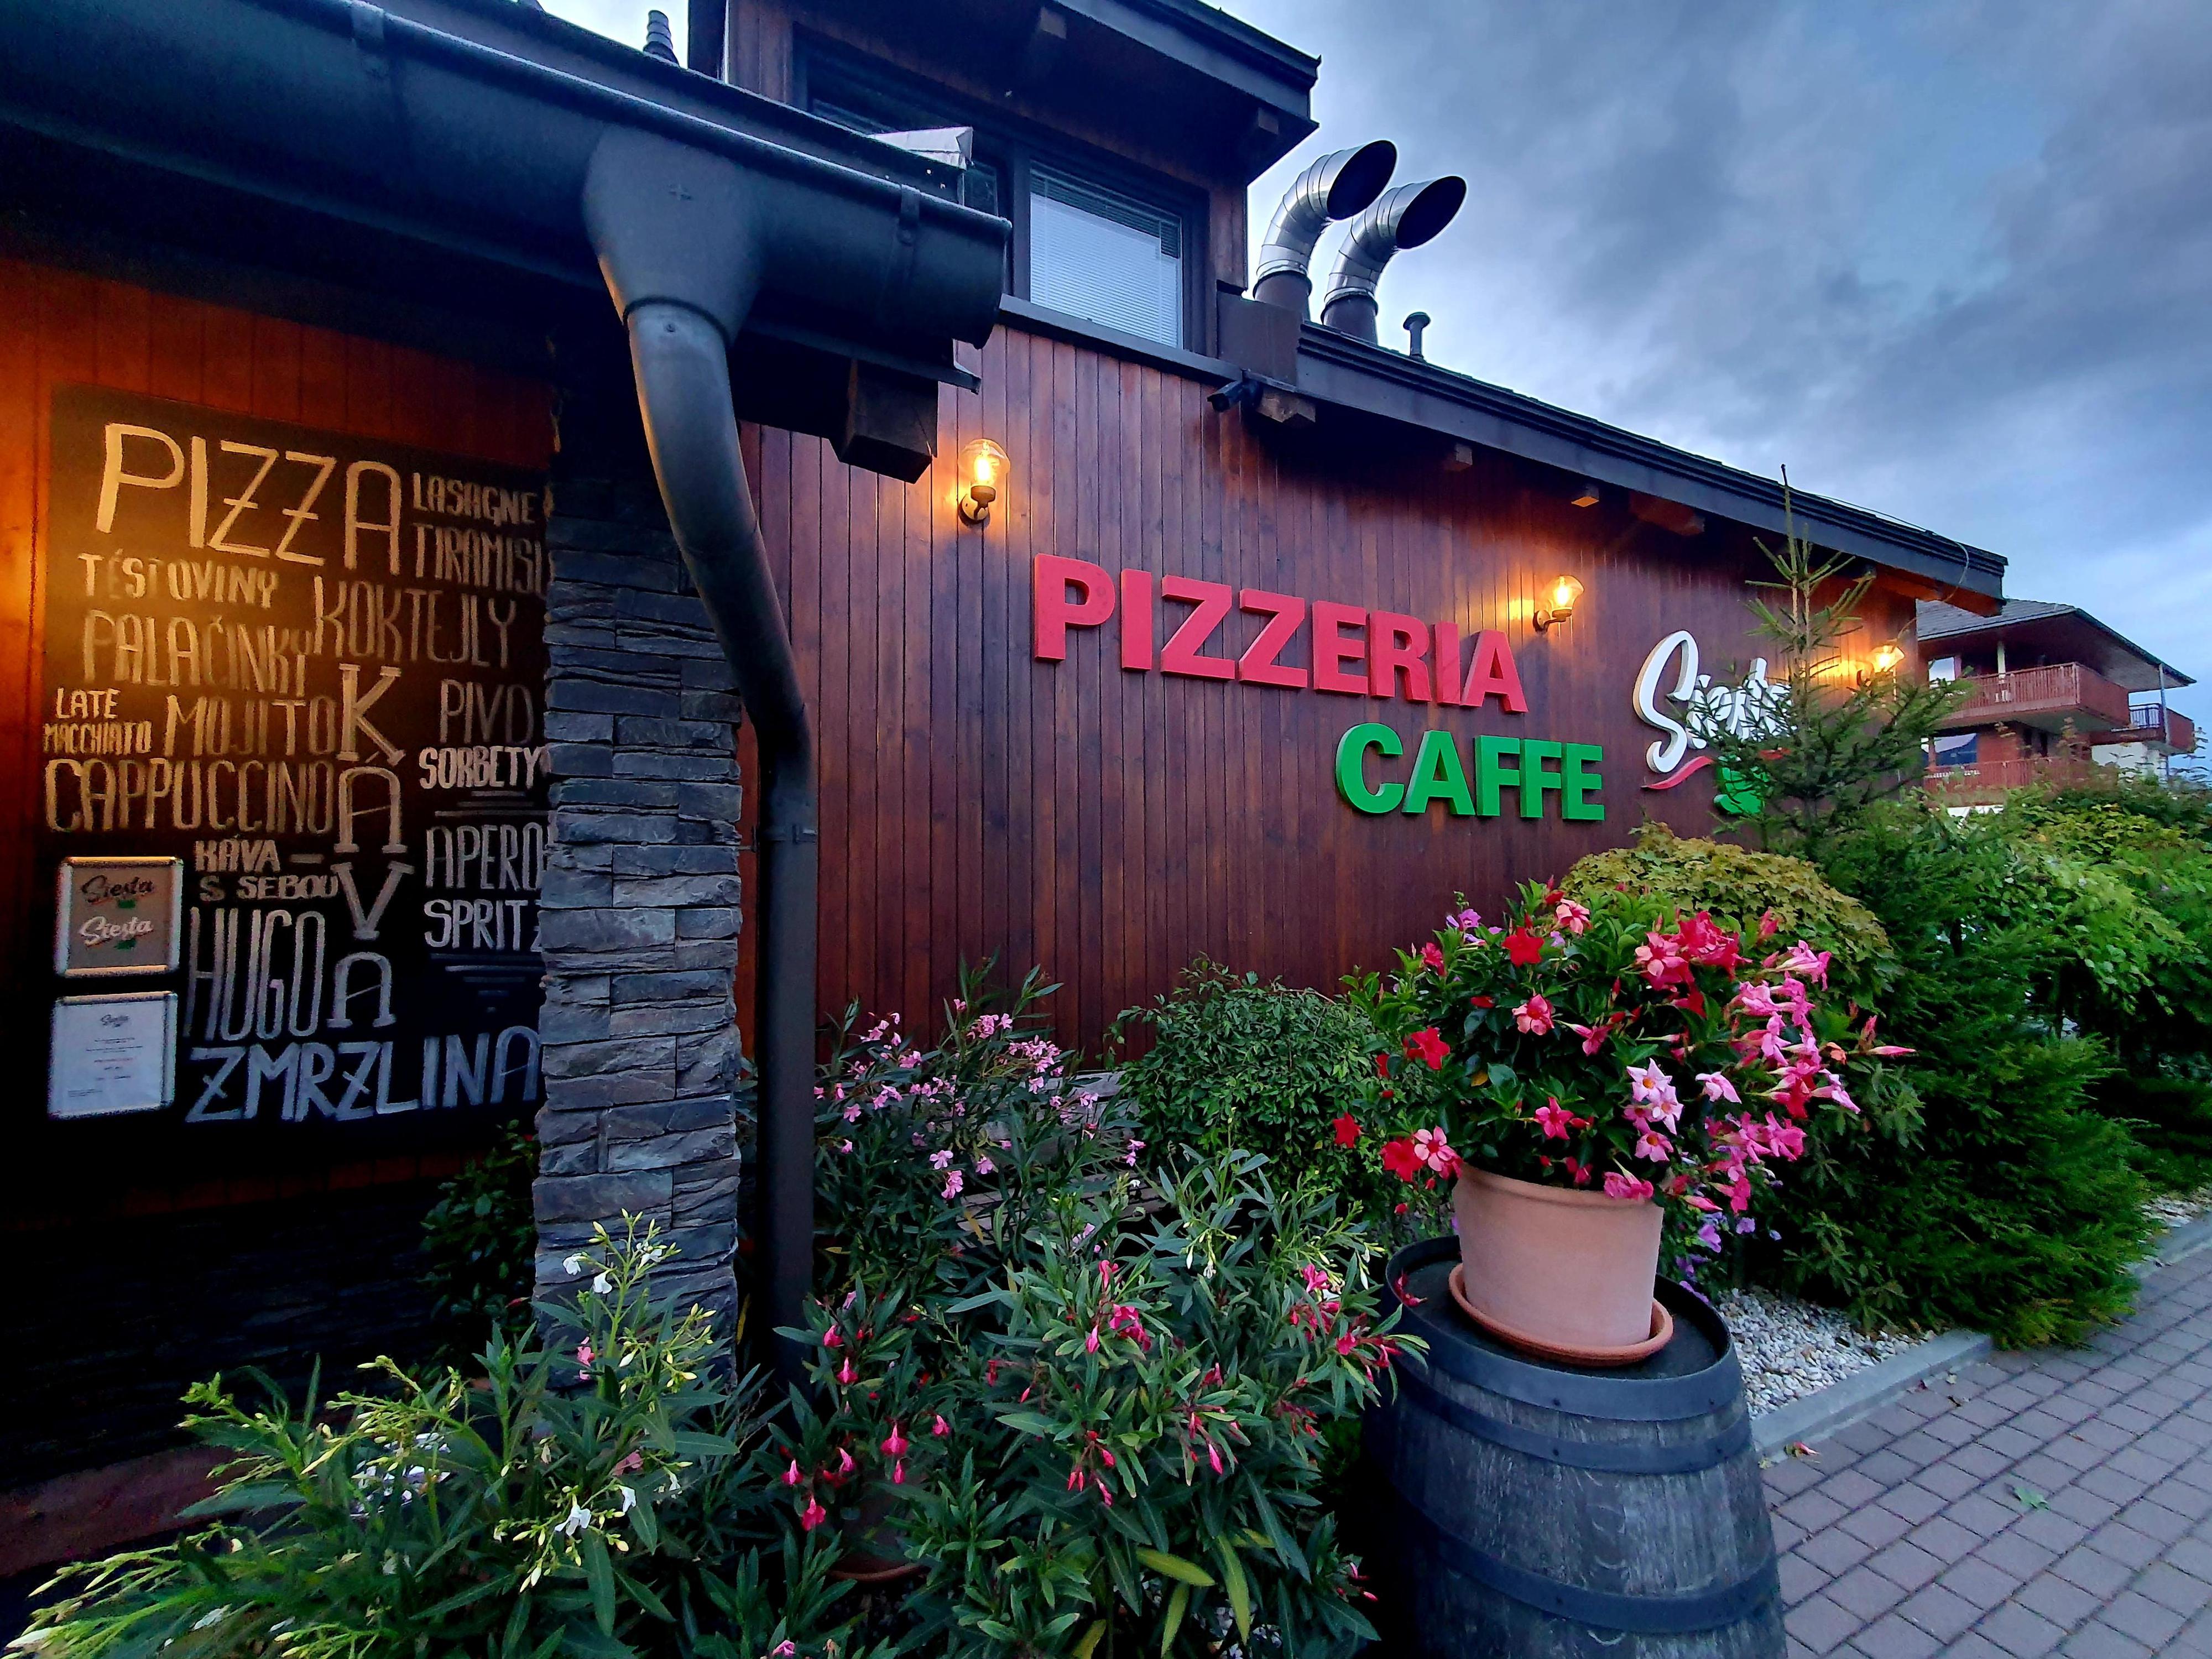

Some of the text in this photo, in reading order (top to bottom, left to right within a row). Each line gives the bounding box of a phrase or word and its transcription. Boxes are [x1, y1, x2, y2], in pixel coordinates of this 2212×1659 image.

[96, 422, 403, 575] PIZZA
[413, 472, 538, 526] LASAGNE
[313, 575, 516, 669] KOKTEJLY
[1034, 552, 1528, 713] PIZZERIA
[56, 687, 121, 719] LATE
[164, 695, 335, 757] MOJITO
[440, 678, 534, 744] PIVO
[43, 721, 152, 755] MACCHIATO
[419, 745, 542, 790] SORBETY
[44, 758, 333, 834] CAPPUCCINO
[1336, 722, 1605, 821] CAFFE
[200, 875, 338, 902] S SEBOU
[78, 916, 153, 947] Siesta
[183, 906, 326, 1042] HUGO
[185, 1025, 540, 1123] ZMRZLINA
